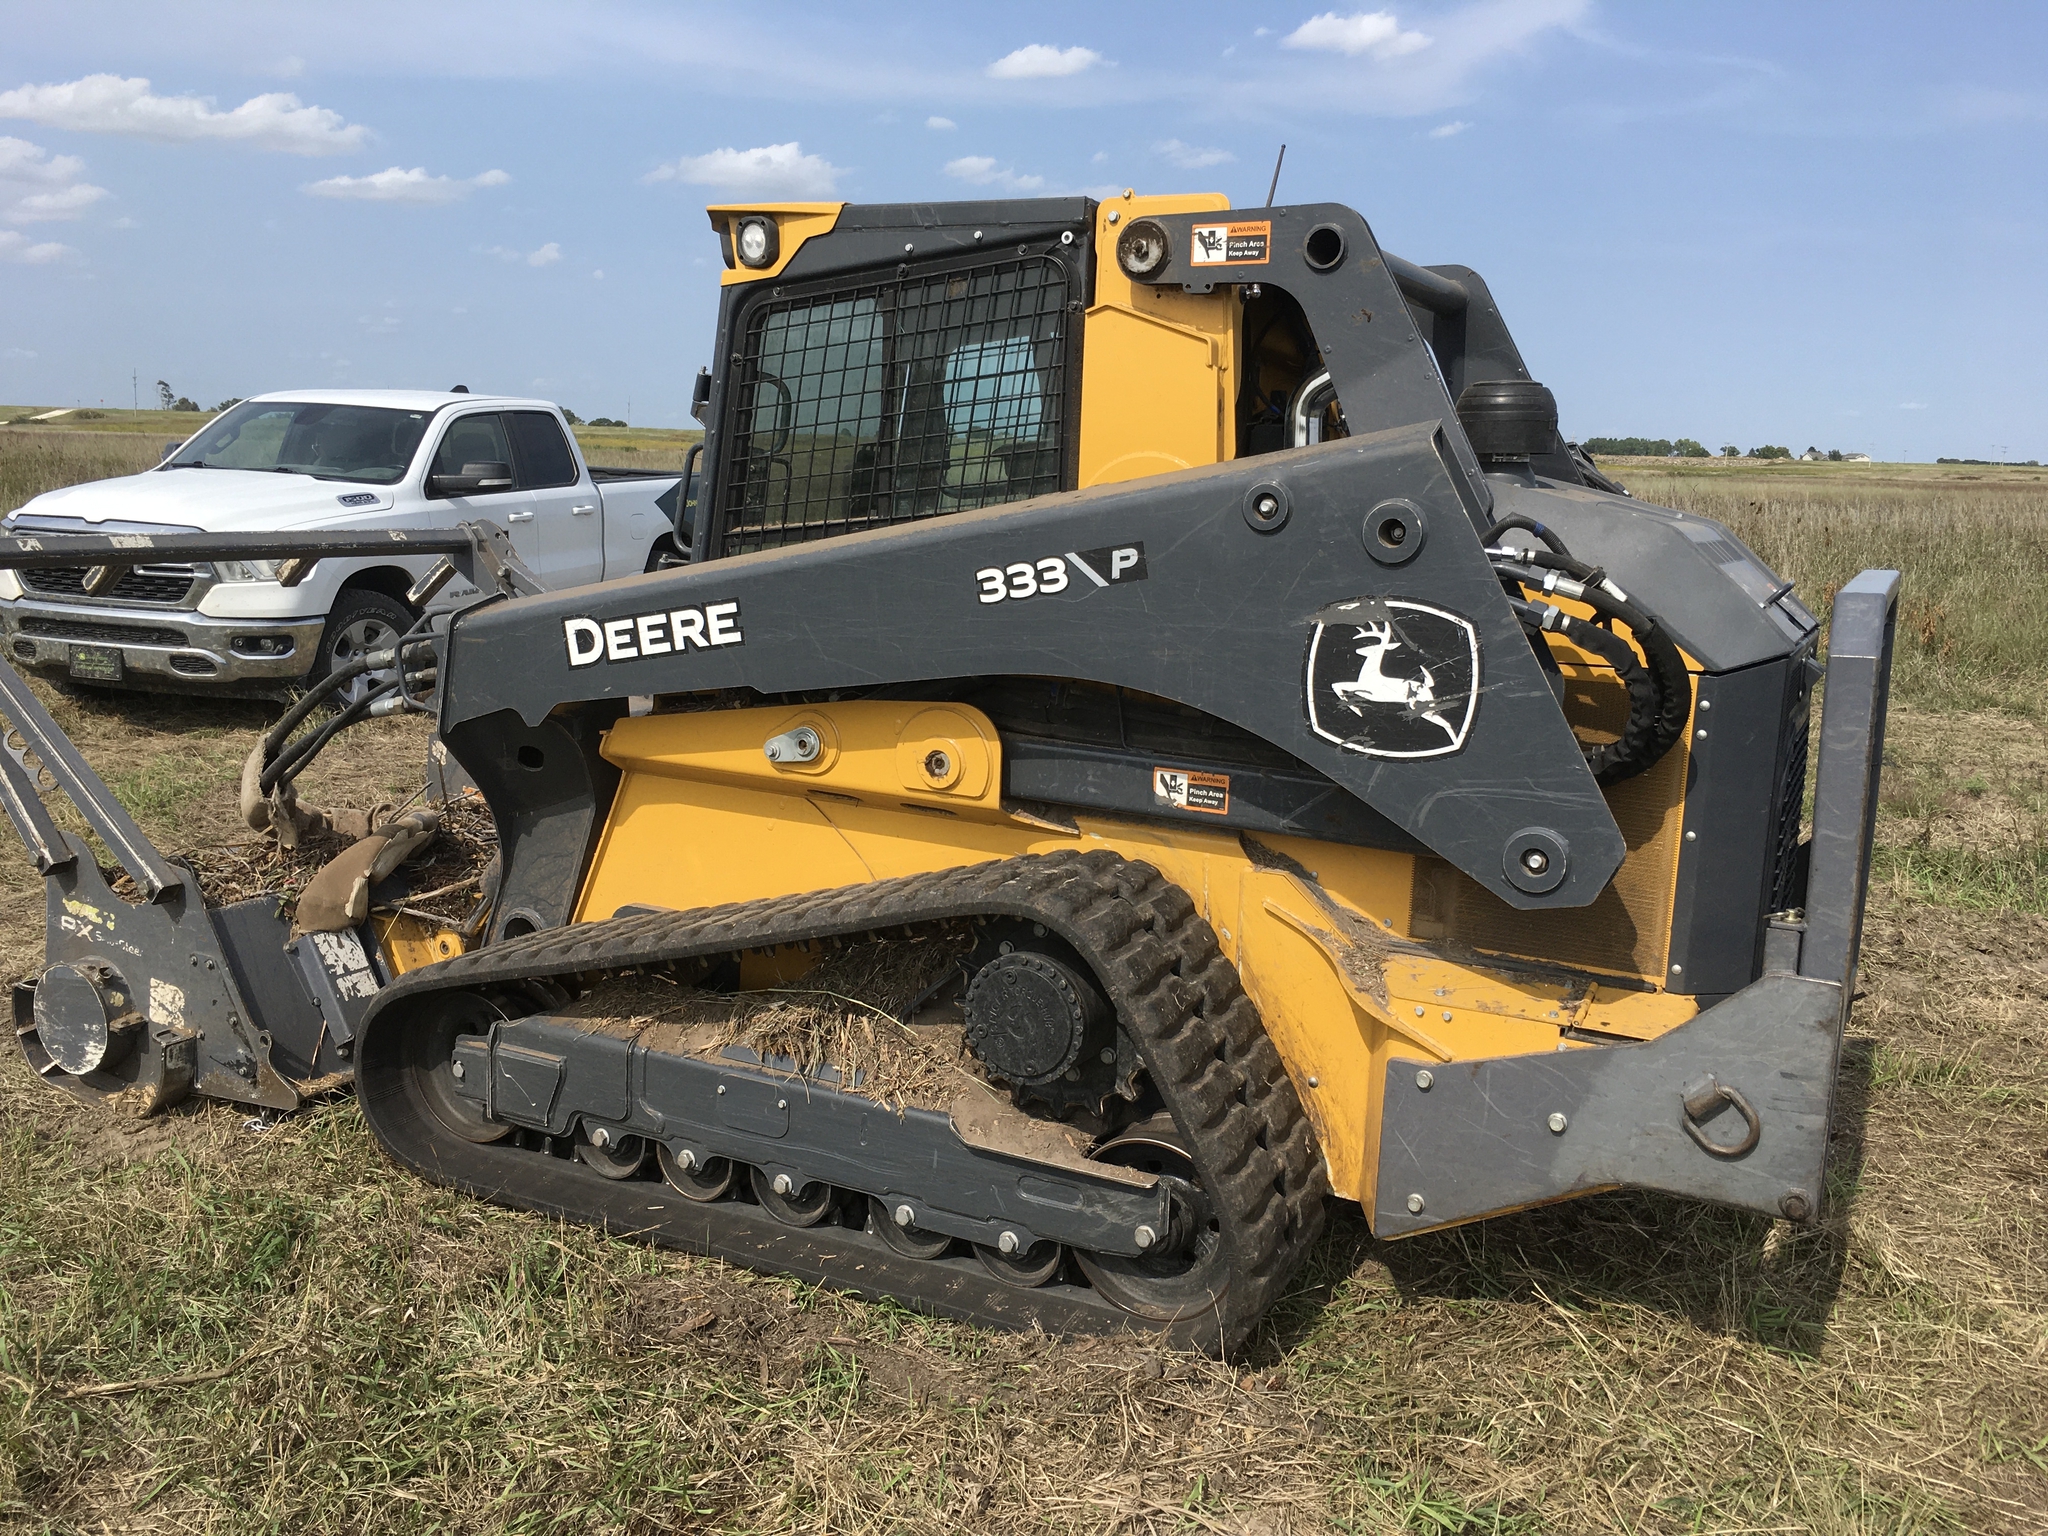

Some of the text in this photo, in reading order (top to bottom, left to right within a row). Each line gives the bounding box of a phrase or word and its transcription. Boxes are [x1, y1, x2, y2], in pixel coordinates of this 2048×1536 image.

[976, 557, 1069, 603] 333
[450, 588, 480, 599] RAM
[564, 602, 742, 666] DEERE
[1197, 776, 1226, 784] WARNING
[1189, 788, 1223, 798] Pinch Area
[1188, 796, 1218, 806] Keep Away
